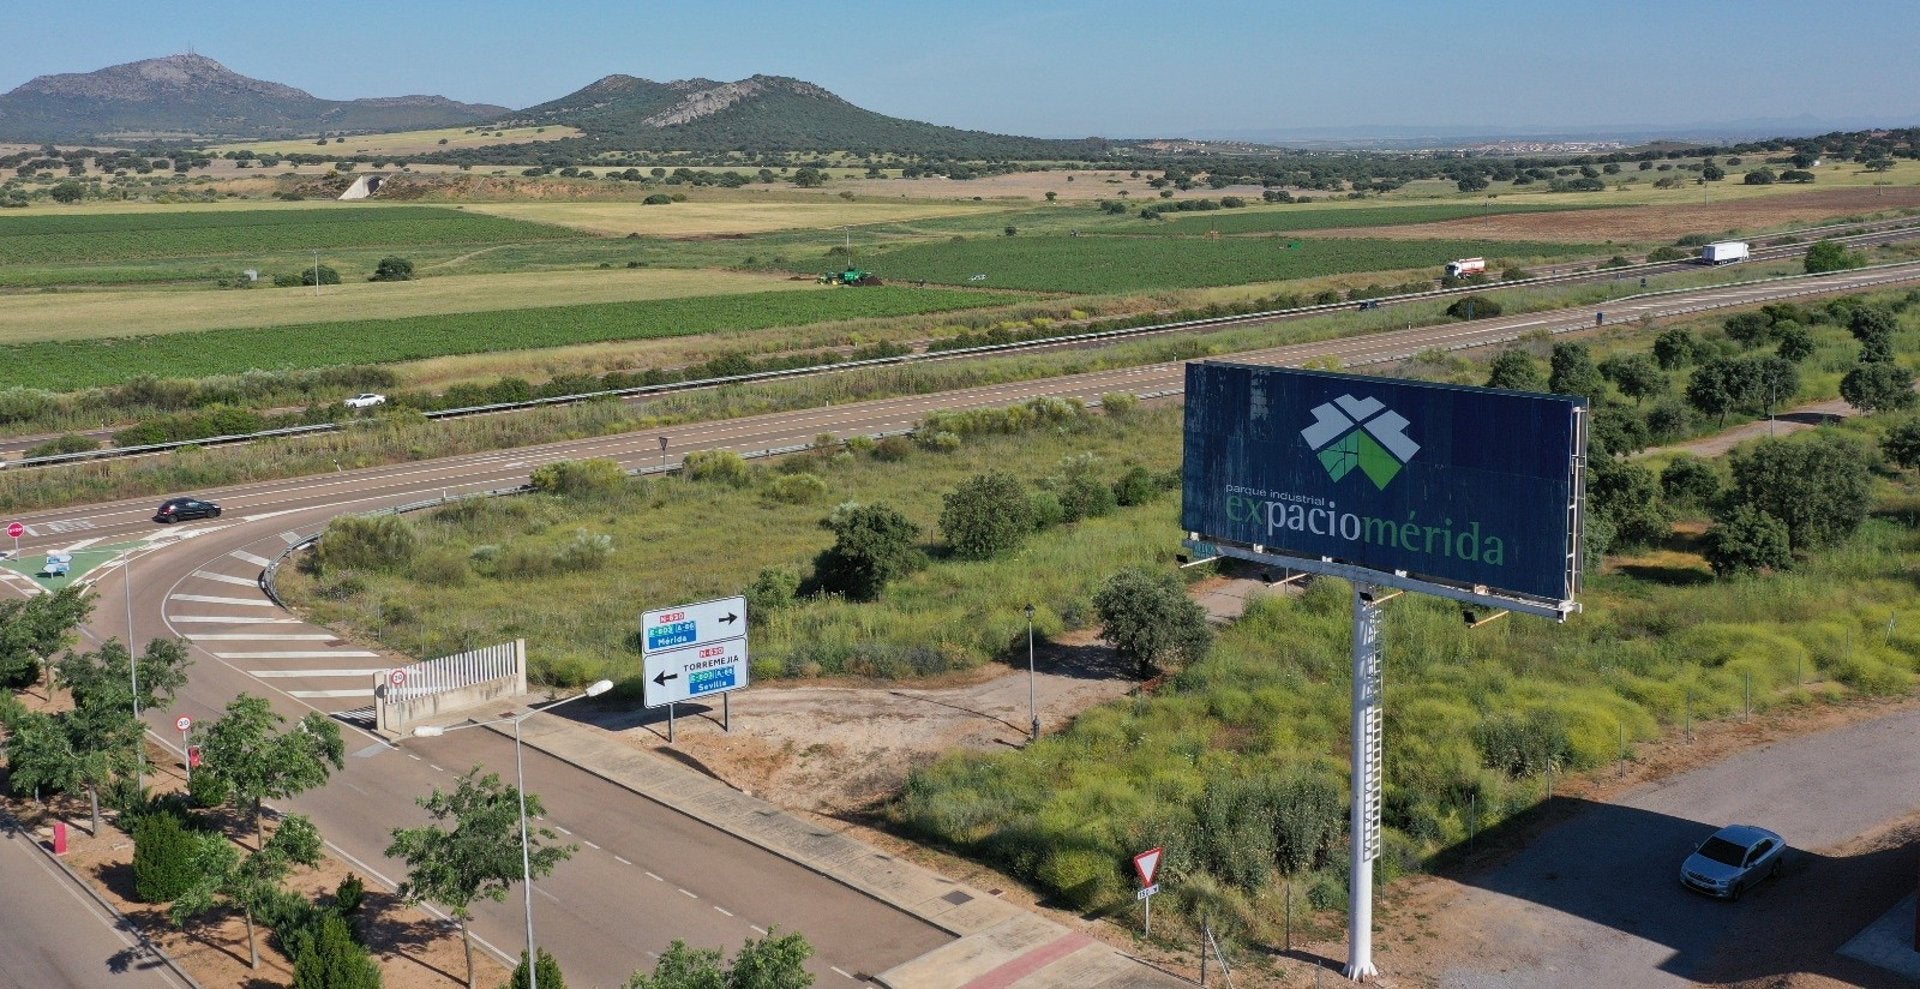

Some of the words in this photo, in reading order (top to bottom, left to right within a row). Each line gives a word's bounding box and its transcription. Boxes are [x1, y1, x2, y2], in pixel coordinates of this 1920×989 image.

[1226, 484, 1267, 497] parque
[1270, 490, 1325, 506] industrial
[658, 635, 687, 646] Mérida
[698, 680, 727, 691] Sevilla
